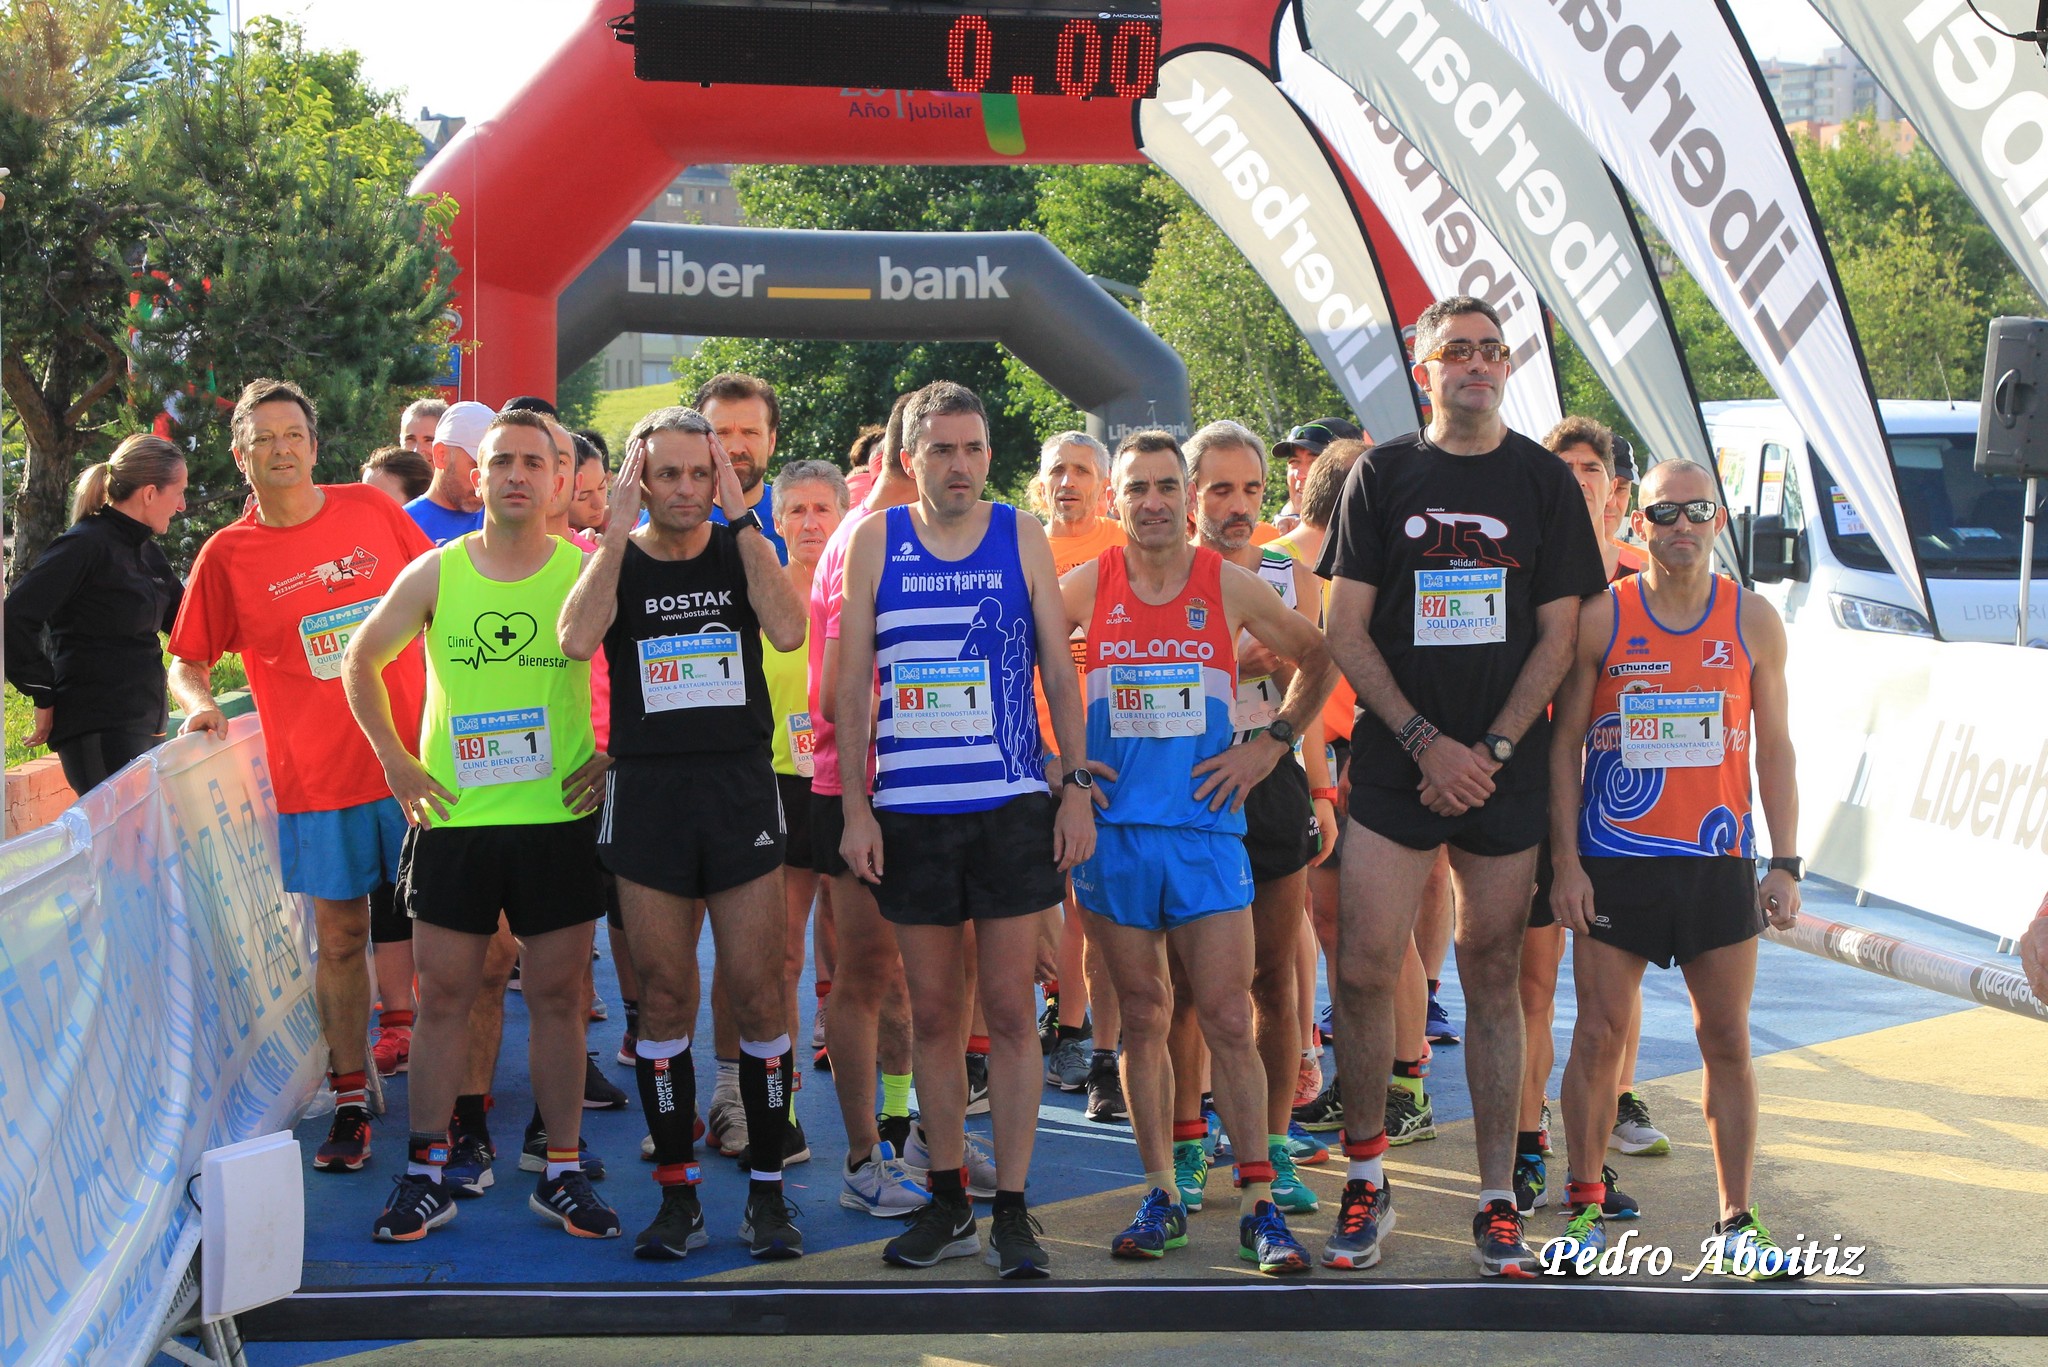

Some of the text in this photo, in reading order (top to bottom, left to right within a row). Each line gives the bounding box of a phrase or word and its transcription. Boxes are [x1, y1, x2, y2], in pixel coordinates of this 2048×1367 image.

[848, 101, 972, 121] Año Jubilar
[626, 246, 1010, 301] Liber bank
[276, 571, 307, 588] Santander
[1445, 573, 1498, 583] IMEM
[645, 590, 733, 614] BOSTAK
[1424, 596, 1445, 617] 37
[1484, 593, 1495, 616] 1
[329, 603, 377, 622] IMEM
[661, 608, 721, 622] www.bostak.es
[313, 634, 336, 657] 14
[447, 635, 474, 648] Clinic
[674, 637, 732, 648] IMEM
[317, 653, 343, 665] QUEBR
[518, 654, 569, 669] Bienestar
[651, 661, 675, 683] 27
[717, 656, 730, 679] 1
[922, 666, 980, 675] IMEM
[1138, 668, 1195, 677] IMEM
[1619, 663, 1670, 673] Thunder
[679, 681, 720, 689] RESTAURANTE
[1256, 680, 1269, 702] 1
[906, 688, 918, 710] 3
[963, 685, 976, 709] 1
[1118, 688, 1139, 710] 15
[1178, 687, 1191, 710] 1
[1657, 697, 1716, 706] IMEM
[480, 711, 539, 724] IMEM
[896, 711, 914, 719] CORRE
[940, 709, 989, 717] DONOSTIARRAK
[1166, 710, 1202, 718] POLANCO
[1632, 718, 1656, 740] 28
[1699, 716, 1710, 740] 1
[460, 737, 484, 758] 19
[524, 731, 538, 754] 1
[1626, 741, 1715, 749] CORRIENDOENSANTANDER
[463, 754, 545, 770] CLINIC BIENESTAR 2
[1909, 719, 2048, 857] Liberb
[754, 838, 775, 847] adidas
[1976, 966, 2048, 1017] iberbank
[665, 1081, 675, 1112] SPORT
[774, 1080, 784, 1107] SPORT
